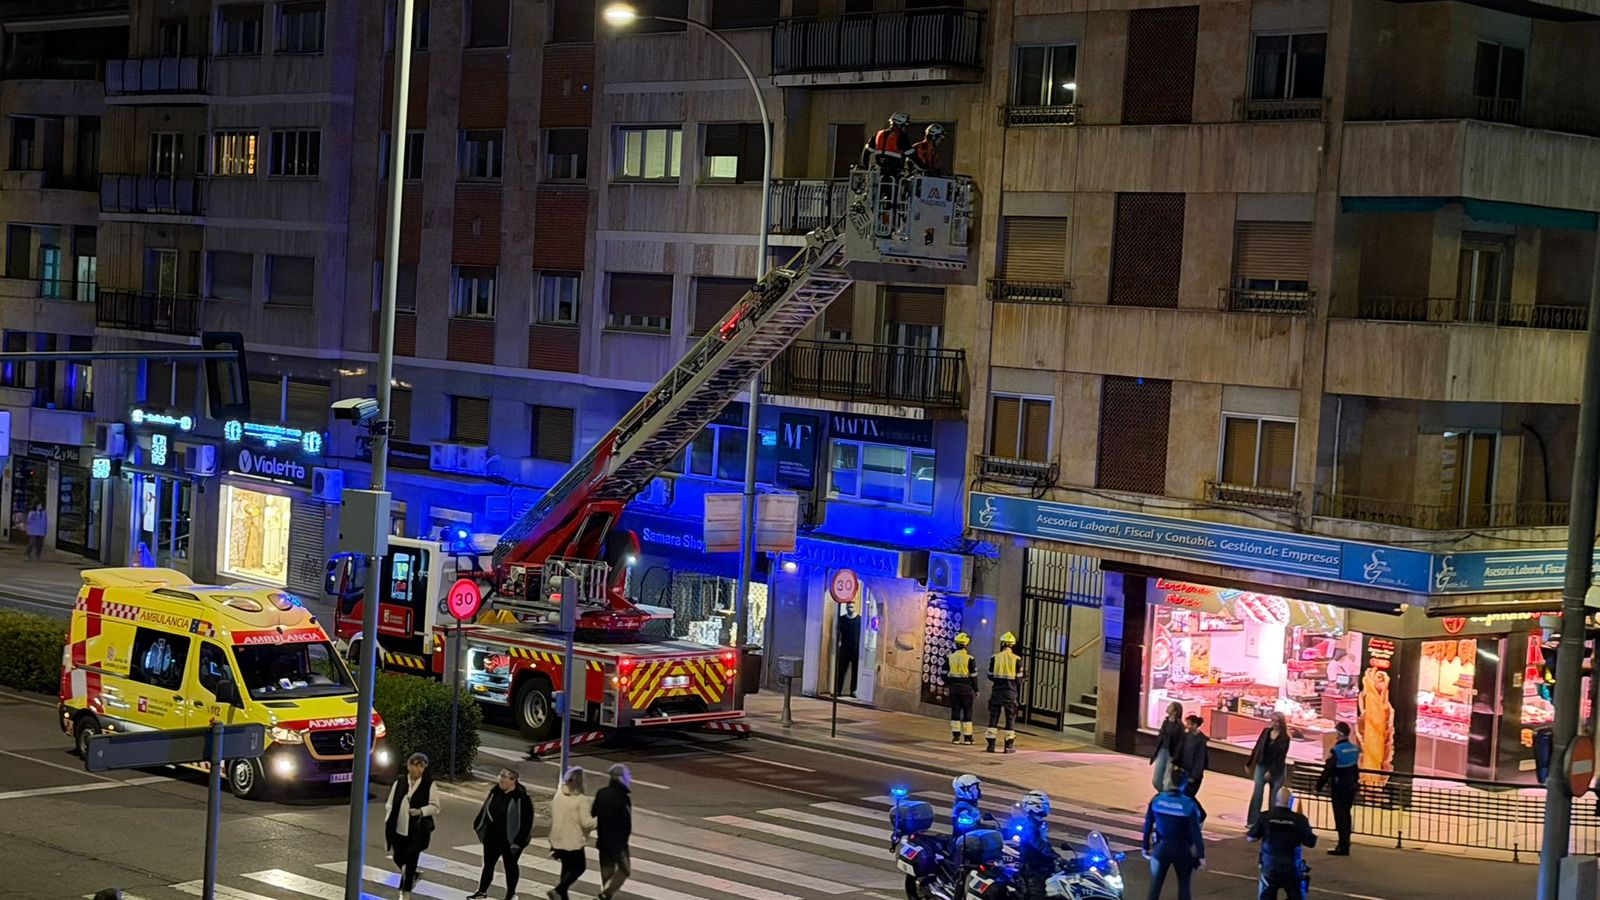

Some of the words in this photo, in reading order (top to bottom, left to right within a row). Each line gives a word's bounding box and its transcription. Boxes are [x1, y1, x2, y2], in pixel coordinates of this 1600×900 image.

[254, 455, 305, 479] Violetta
[643, 527, 681, 546] Samara
[1080, 520, 1120, 535] Laboral,
[1124, 526, 1154, 539] Fiscal
[1155, 531, 1163, 542] y
[1165, 532, 1217, 548] Contable.
[1220, 539, 1262, 554] Gestión
[1264, 545, 1279, 556] de
[1281, 547, 1339, 565] Empresas
[837, 580, 852, 591] 30
[455, 592, 473, 605] 30
[139, 611, 190, 630] AMBULANCIA
[243, 633, 320, 645] AMBULANCIA
